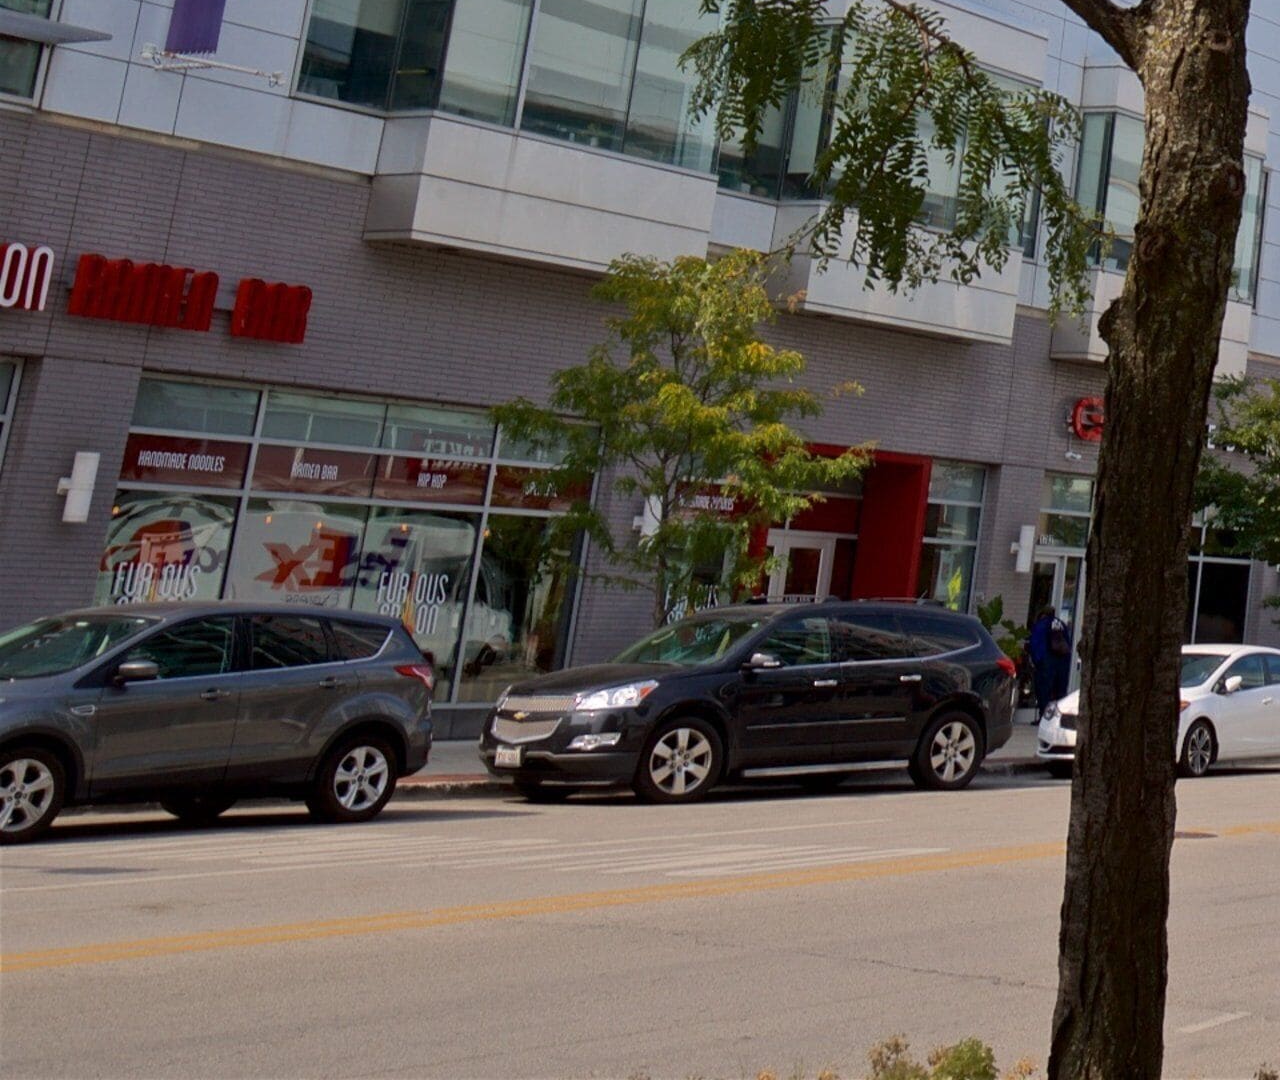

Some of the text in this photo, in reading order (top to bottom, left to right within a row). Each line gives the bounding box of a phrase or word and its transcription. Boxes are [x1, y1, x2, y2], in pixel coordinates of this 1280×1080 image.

[137, 450, 226, 473] HANDMADE NOODLES
[321, 463, 339, 481] BAR
[416, 472, 448, 490] HIP HOP
